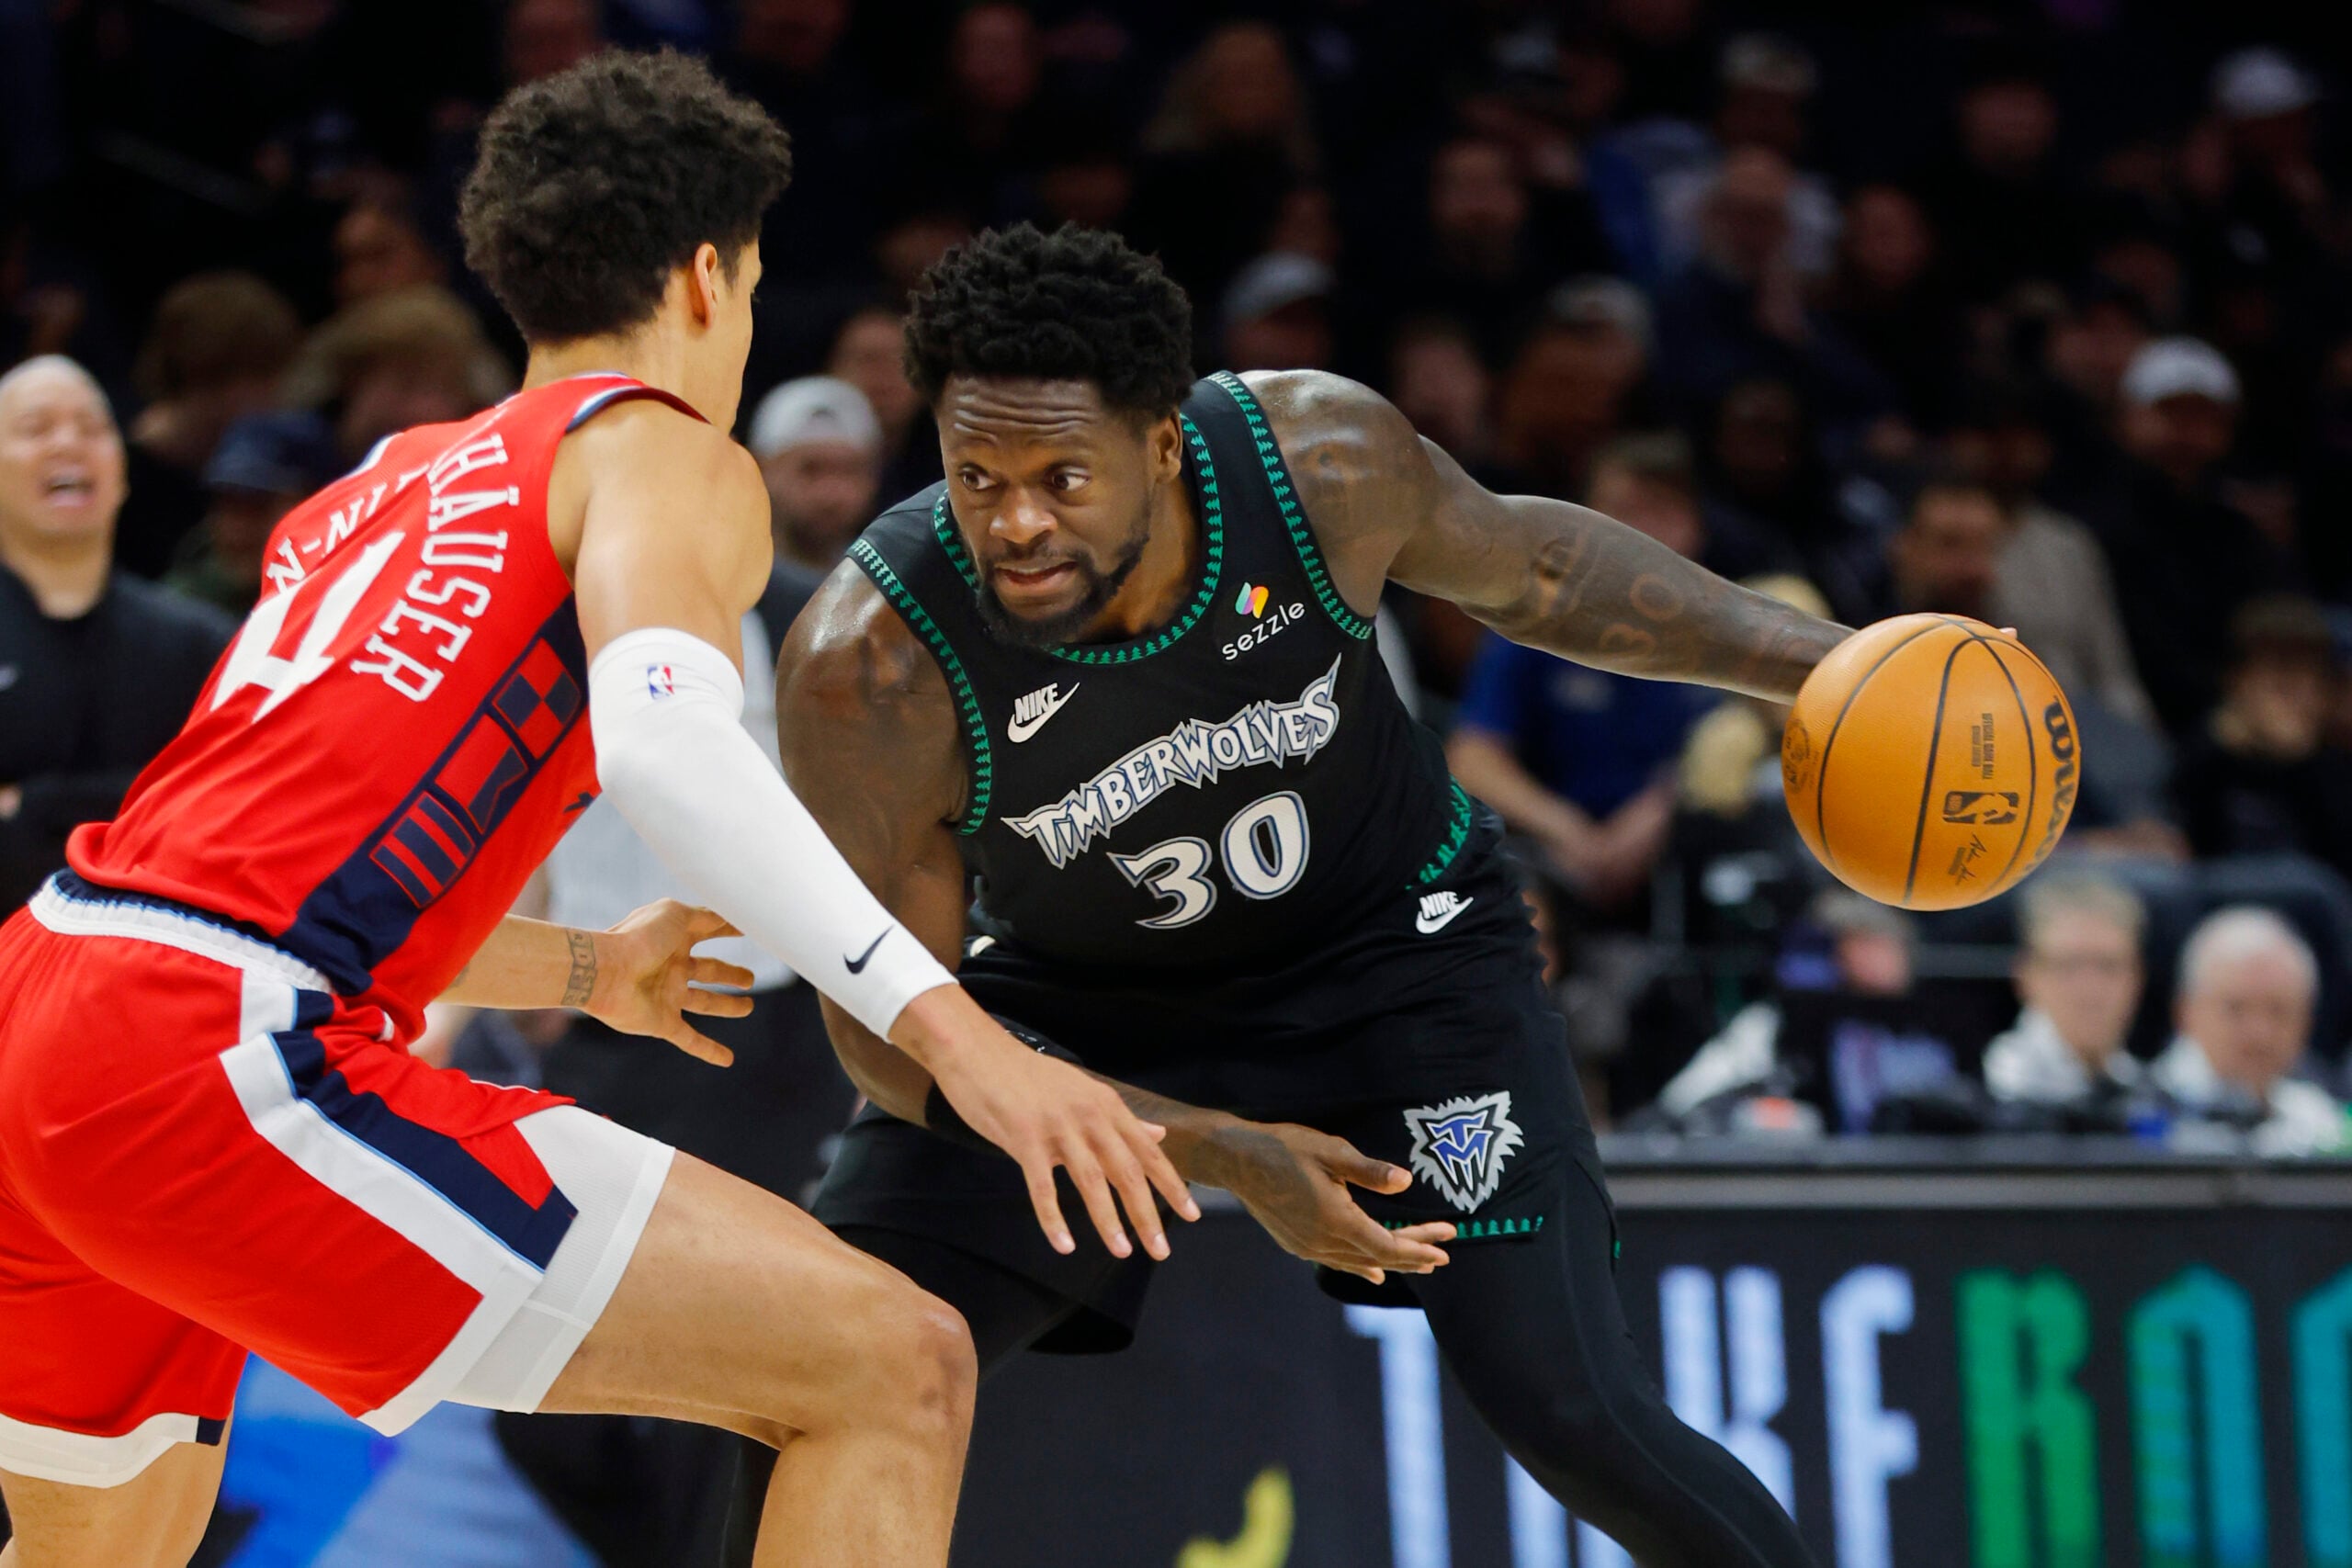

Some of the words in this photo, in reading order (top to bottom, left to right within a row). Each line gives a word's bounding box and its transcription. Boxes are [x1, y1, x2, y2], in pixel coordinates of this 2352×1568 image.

[1222, 602, 1306, 660] sezzle
[1013, 682, 1059, 725] NIKE
[1001, 652, 1342, 870] TIMBERWOLVES
[1106, 790, 1311, 930] 30
[1419, 890, 1461, 919] NIKE
